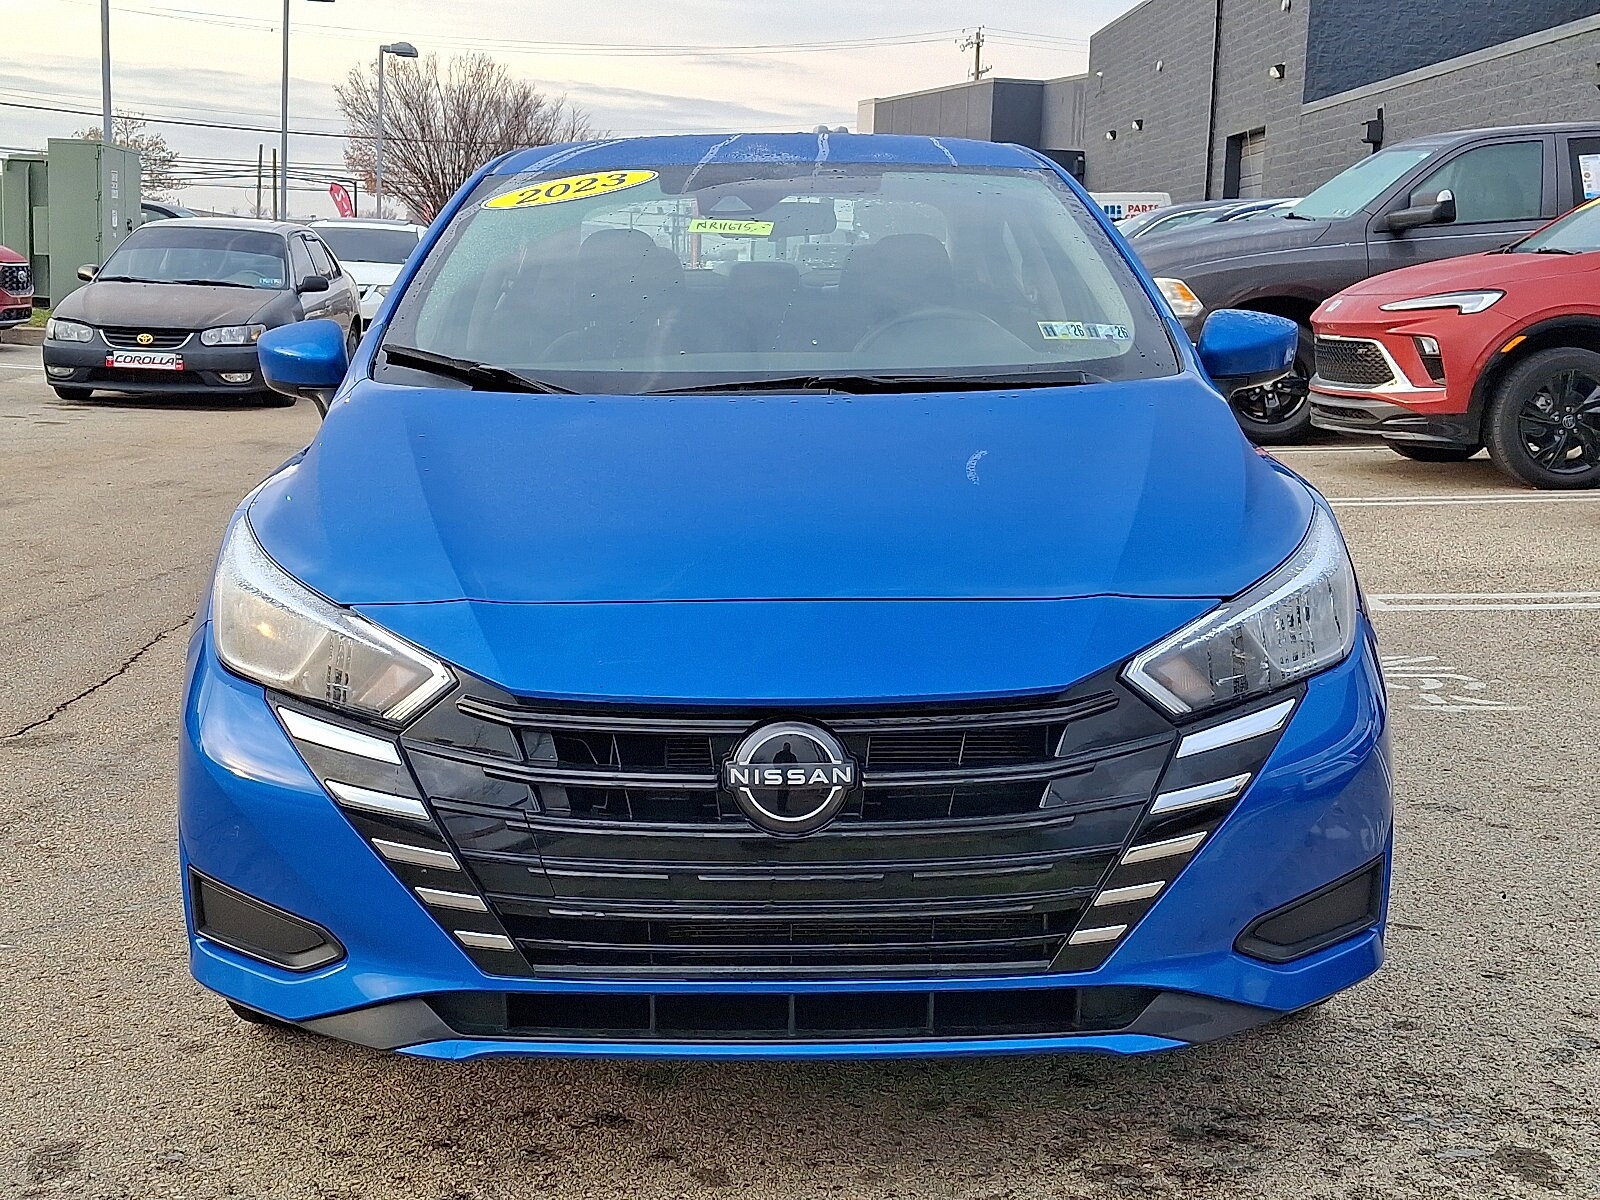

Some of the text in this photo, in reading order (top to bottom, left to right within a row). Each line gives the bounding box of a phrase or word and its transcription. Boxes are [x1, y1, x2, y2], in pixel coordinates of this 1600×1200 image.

[516, 173, 628, 205] 2023
[1071, 325, 1084, 337] 26
[1115, 326, 1129, 338] 26
[115, 354, 175, 366] COROLLA
[730, 766, 851, 785] NISSAN
